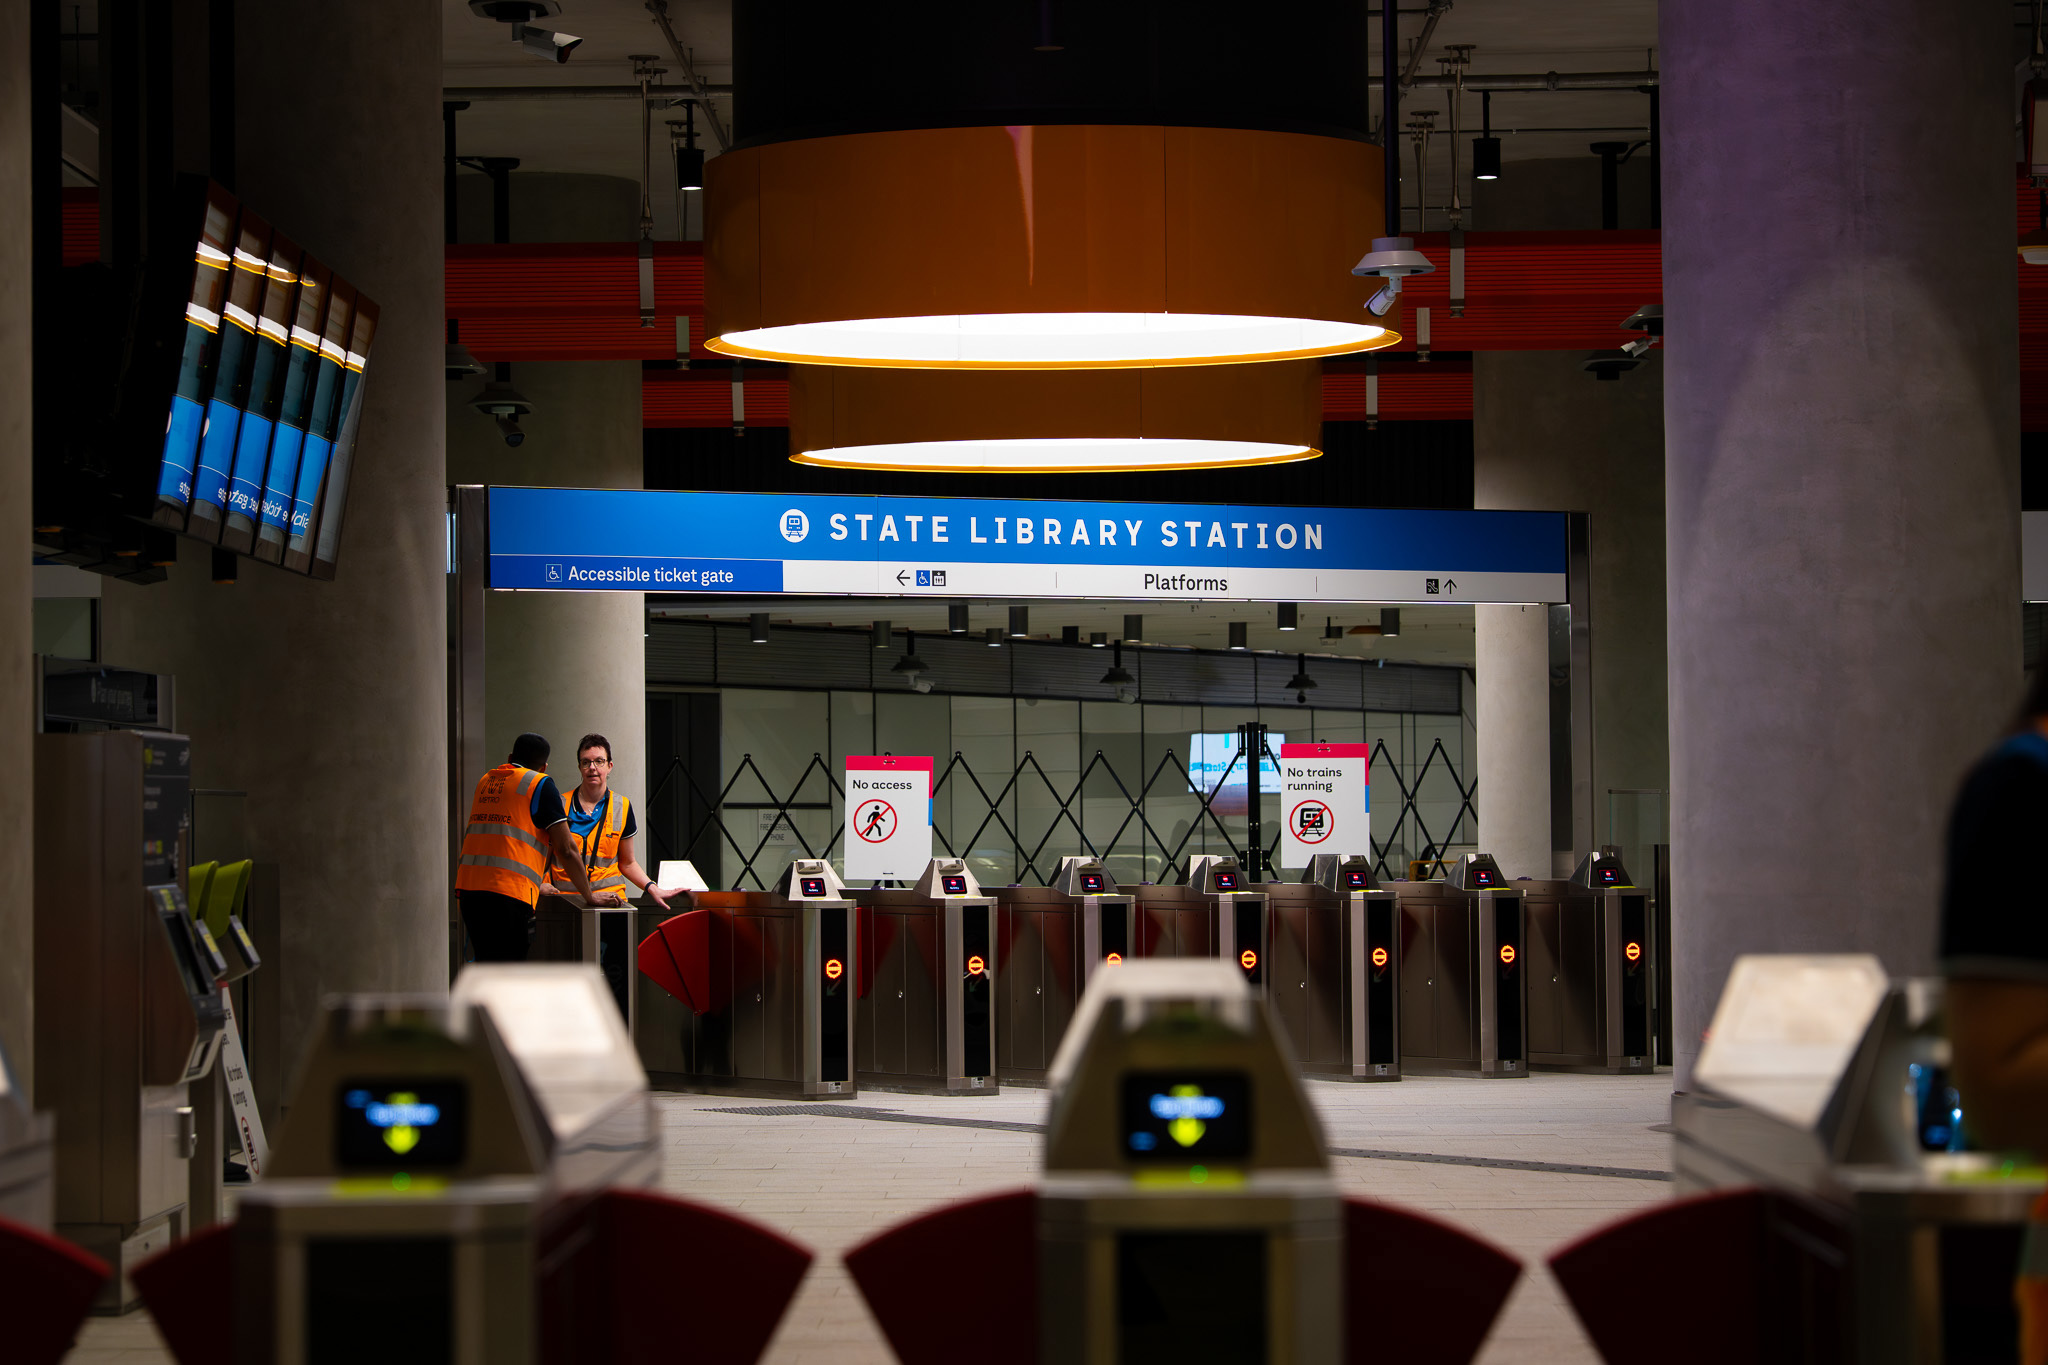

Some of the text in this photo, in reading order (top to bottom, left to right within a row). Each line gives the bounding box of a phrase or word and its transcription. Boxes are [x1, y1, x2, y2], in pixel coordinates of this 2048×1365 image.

[830, 513, 1323, 551] STATE LIBRARY STATION
[568, 565, 734, 587] Accessible ticket gate
[1143, 573, 1228, 592] Platforms
[1287, 767, 1343, 778] No trains
[852, 779, 913, 790] No access
[1287, 780, 1333, 793] running
[479, 796, 500, 804] METRO
[488, 814, 511, 824] SERVICE
